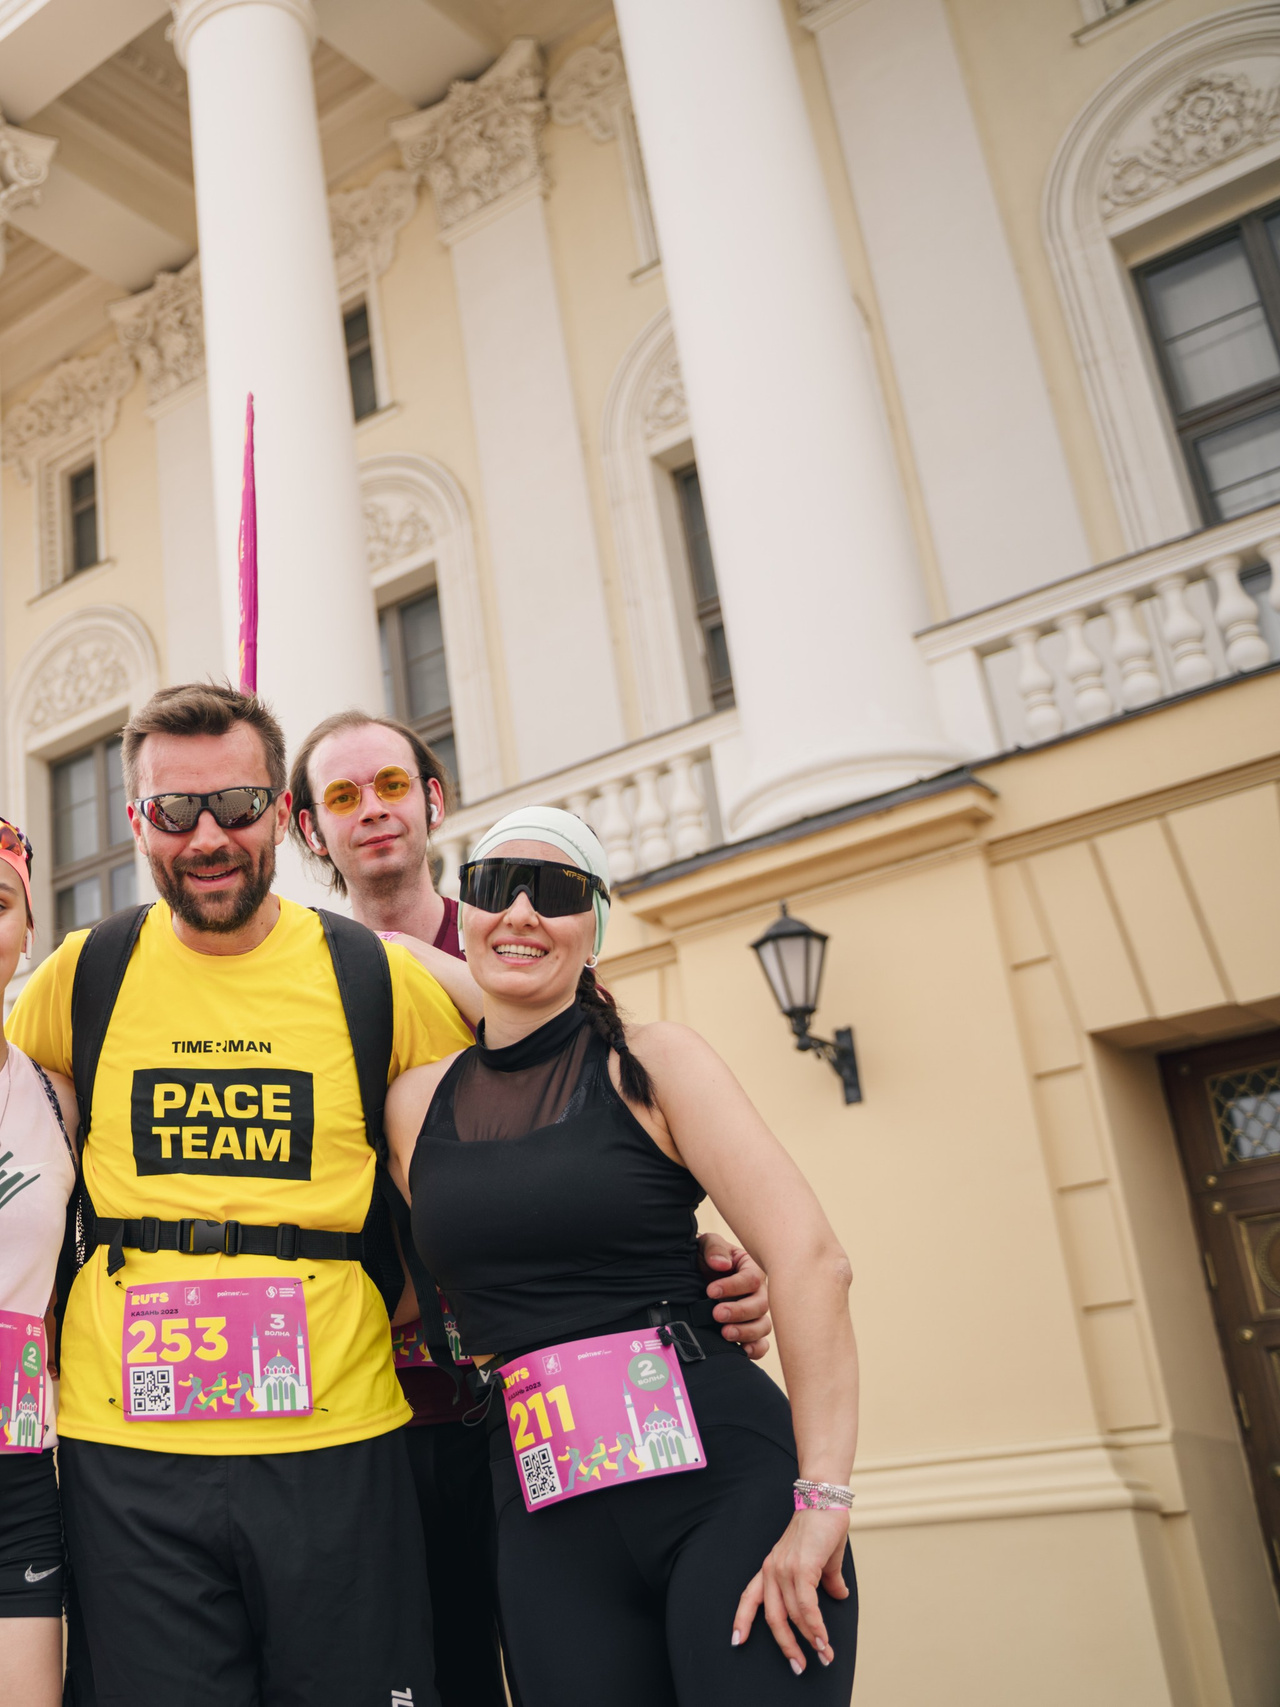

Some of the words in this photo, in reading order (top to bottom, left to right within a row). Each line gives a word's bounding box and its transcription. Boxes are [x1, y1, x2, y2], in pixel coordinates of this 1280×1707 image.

[153, 1082, 292, 1120] PACE
[151, 1126, 291, 1162] TEAM
[130, 1292, 170, 1306] RUTS
[131, 1309, 160, 1317] КАЗАНЬ
[160, 1308, 179, 1316] 2023
[270, 1313, 285, 1329] 3
[127, 1316, 229, 1364] 253
[27, 1347, 37, 1363] 2
[637, 1359, 657, 1377] 2
[524, 1381, 542, 1392] 2023
[637, 1373, 665, 1385] ВОЛНА
[510, 1384, 575, 1451] 211
